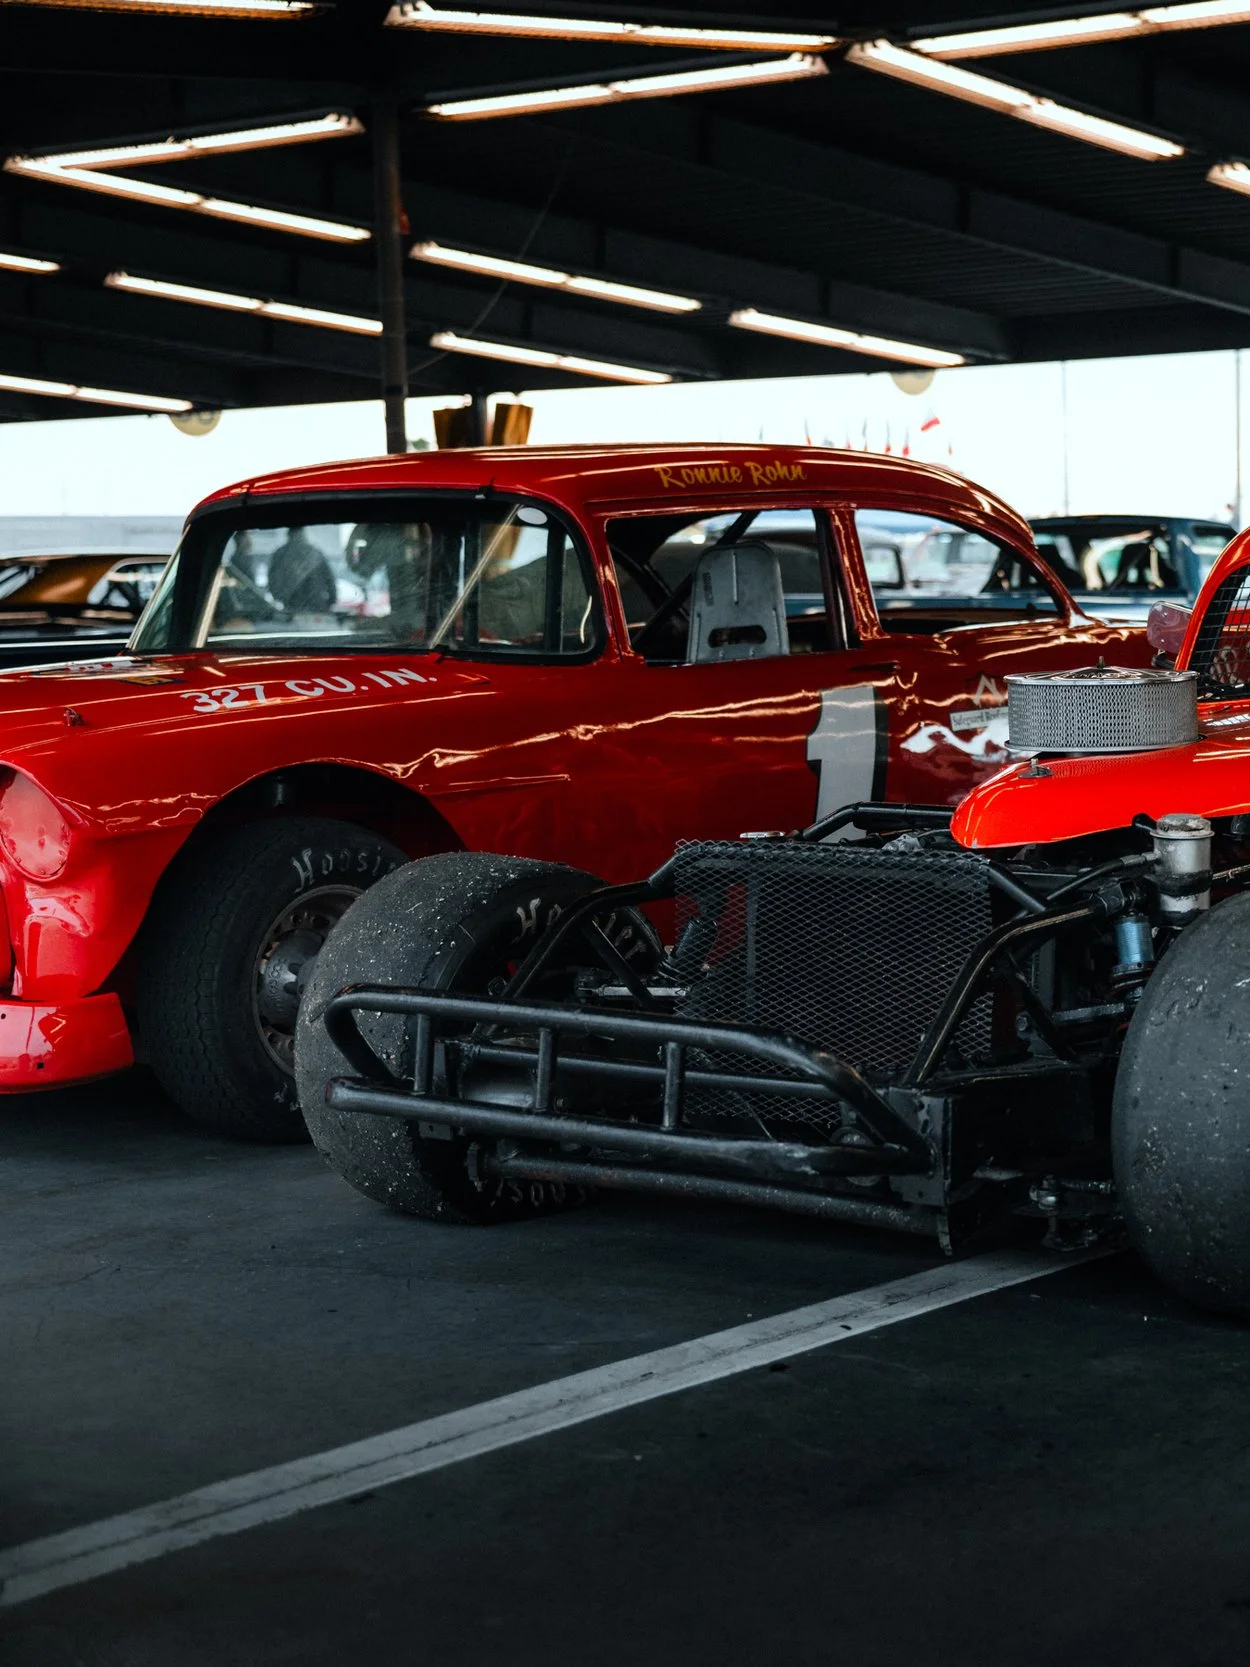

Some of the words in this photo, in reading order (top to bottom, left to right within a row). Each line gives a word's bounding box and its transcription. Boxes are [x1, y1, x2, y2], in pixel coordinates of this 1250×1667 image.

[654, 465, 743, 488] Ronnie
[744, 460, 807, 486] Rohn
[180, 684, 269, 713] 327
[805, 685, 889, 843] 1
